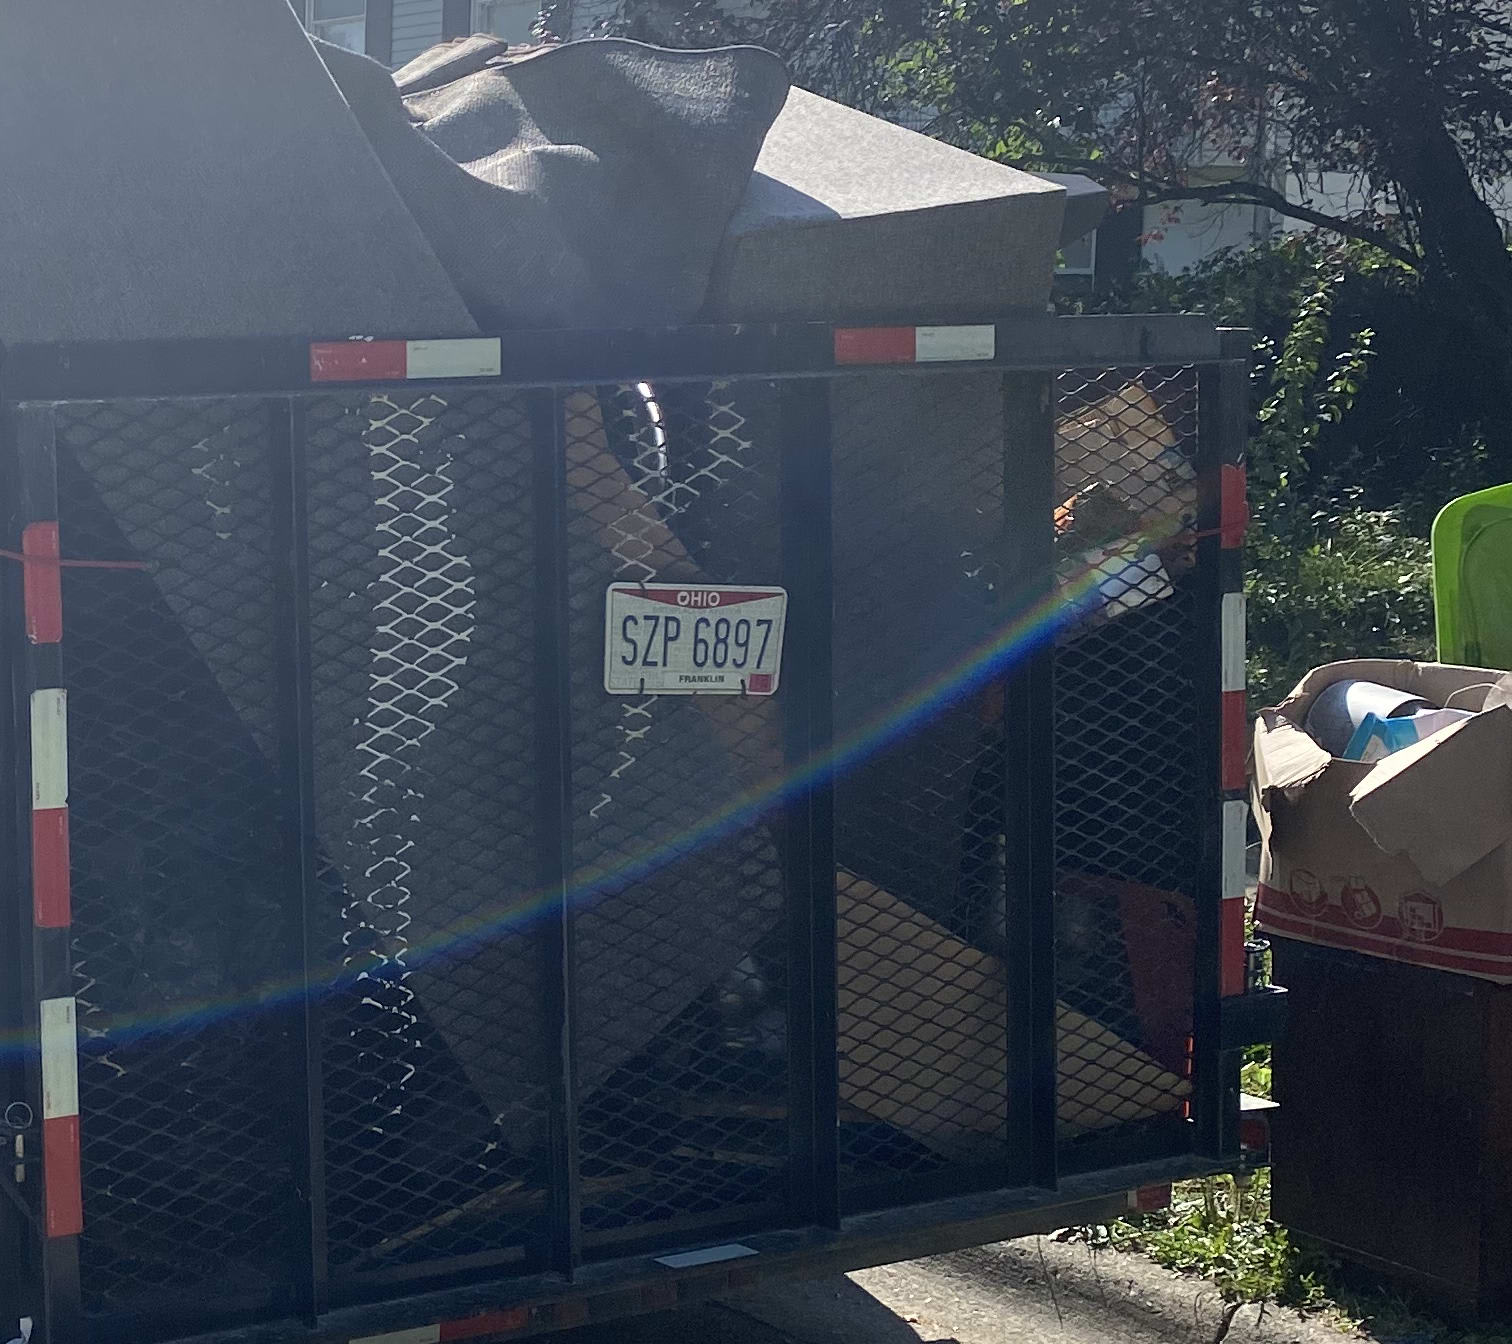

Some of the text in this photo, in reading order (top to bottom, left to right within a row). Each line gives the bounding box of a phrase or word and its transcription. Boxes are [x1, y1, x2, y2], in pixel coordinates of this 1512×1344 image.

[676, 591, 721, 606] OHIO
[621, 614, 773, 670] SZP 6897
[678, 674, 725, 684] FRANKLIN
